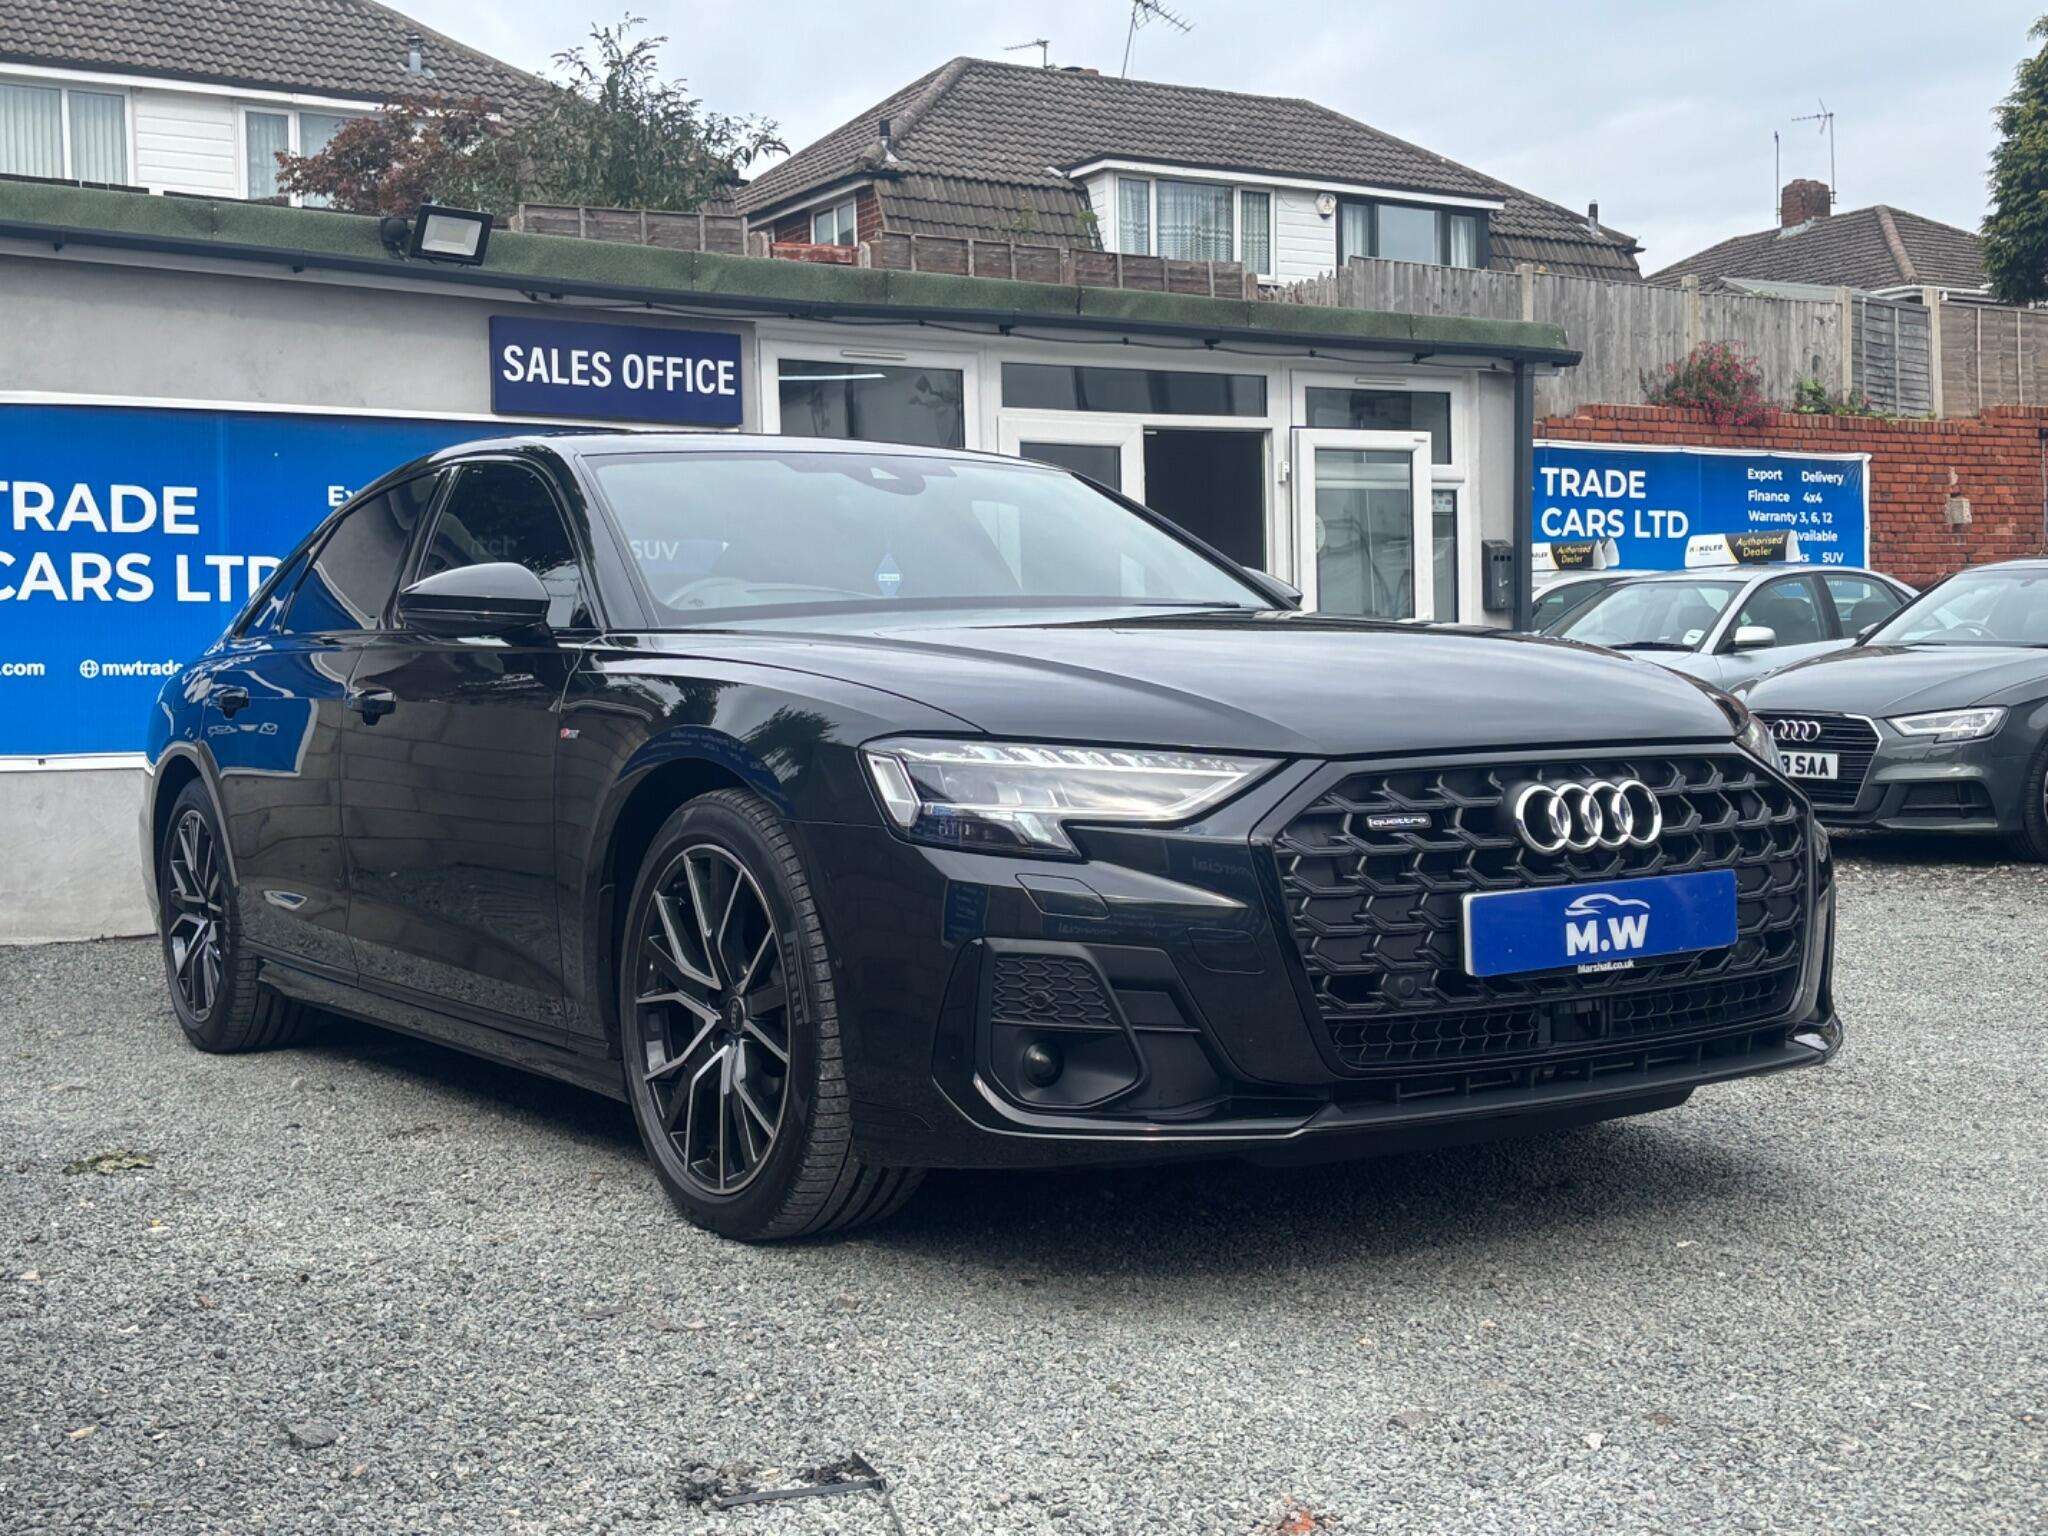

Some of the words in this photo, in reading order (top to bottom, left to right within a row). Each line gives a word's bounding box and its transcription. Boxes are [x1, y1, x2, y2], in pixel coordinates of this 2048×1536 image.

[503, 344, 612, 387] SALES
[622, 353, 736, 395] OFFICE
[1540, 467, 1647, 498] TRADE
[1747, 468, 1783, 482] Export
[1801, 470, 1844, 486] Delivery
[1747, 489, 1790, 502] Finance
[1803, 492, 1823, 503] 4x4
[0, 481, 199, 534] RADE
[1541, 507, 1625, 538] CARS
[1634, 509, 1689, 538] LTD
[1747, 510, 1797, 525] Warranty
[1799, 511, 1809, 524] 3,
[1810, 512, 1821, 525] 6,
[1822, 512, 1833, 523] 12
[1736, 535, 1784, 547] Authorised
[1796, 529, 1838, 542] vailable
[629, 540, 680, 560] SUV
[1743, 545, 1772, 557] Dealer
[1822, 551, 1844, 563] SUV
[1795, 755, 1829, 777] SAA
[1566, 914, 1649, 957] M.W
